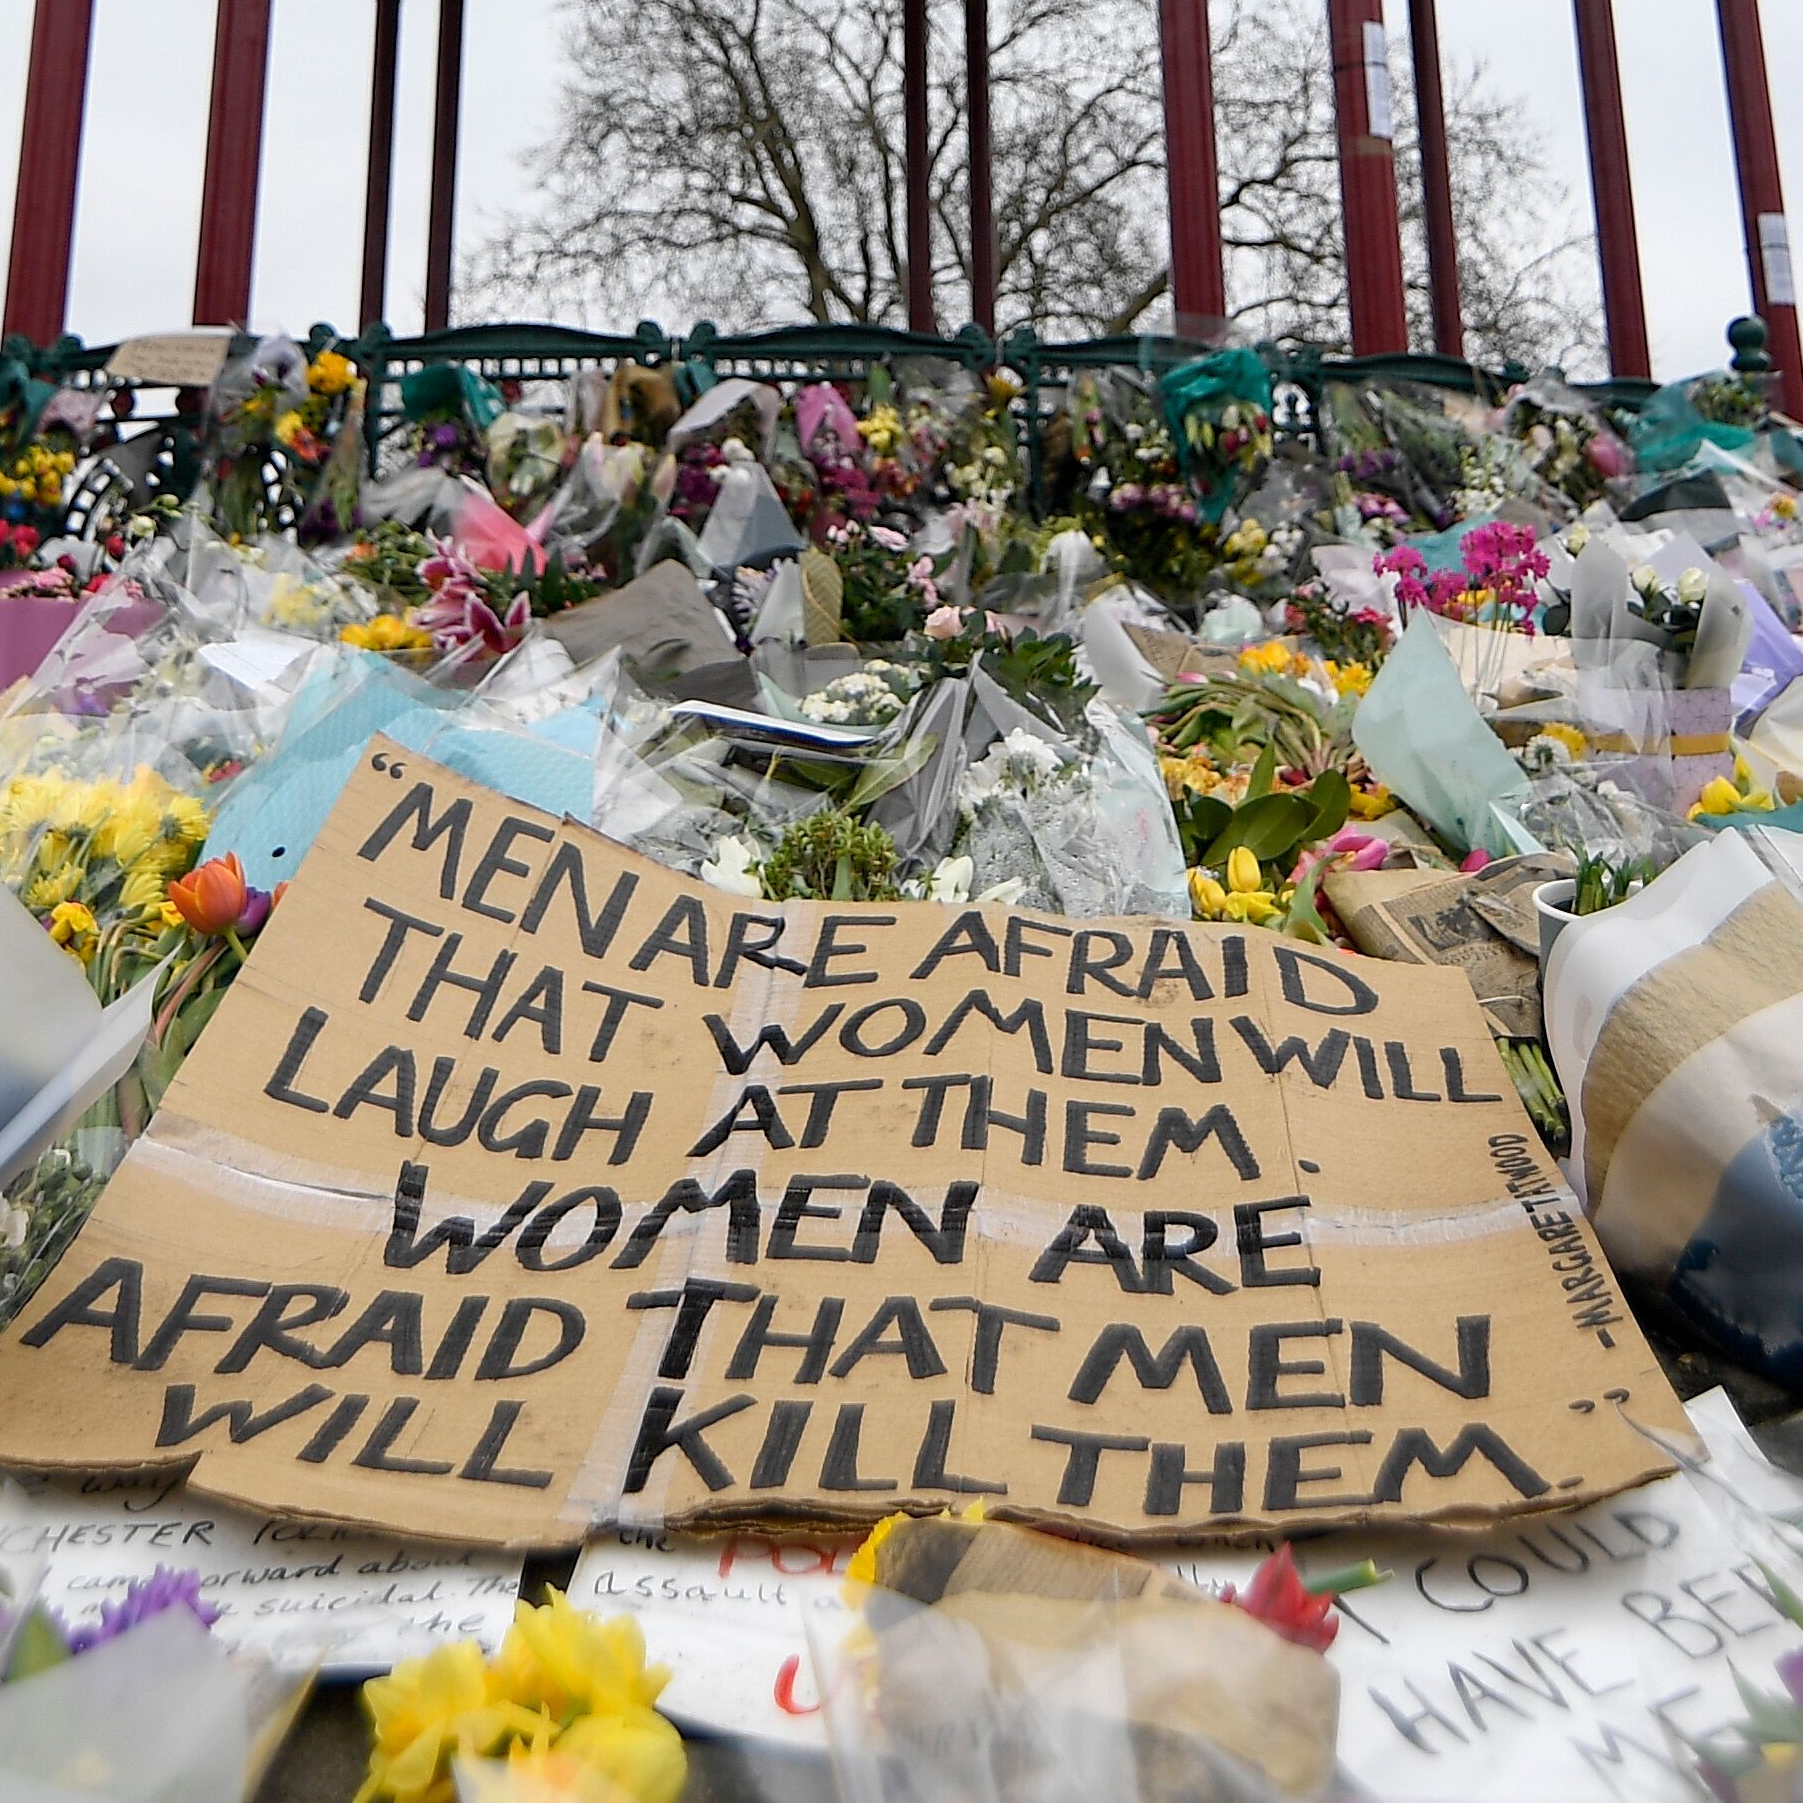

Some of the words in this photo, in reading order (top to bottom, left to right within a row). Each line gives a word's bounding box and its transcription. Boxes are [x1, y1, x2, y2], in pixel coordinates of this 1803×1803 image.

[358, 897, 664, 1063] THAT
[702, 989, 1223, 1086] WOMEN
[1229, 1015, 1503, 1103] WILL
[630, 909, 897, 989] ARE
[910, 911, 1379, 1016] AFRAID
[264, 1006, 654, 1166] LAUGH
[687, 1078, 884, 1158] AT
[902, 1072, 1320, 1181] THEM.
[1488, 1134, 1556, 1199] ATWOOD
[383, 1160, 978, 1275] WOMEN
[1030, 1196, 1322, 1295] ARE
[20, 1256, 586, 1382] AFRAID
[626, 1278, 1060, 1395] THAT
[1067, 1314, 1492, 1414] MEN
[155, 1383, 553, 1489] WILL
[623, 1387, 1008, 1494] KILL
[199, 1553, 345, 1589] orward
[1415, 1510, 1679, 1612] COULD
[1367, 1628, 1635, 1754] HAVE
